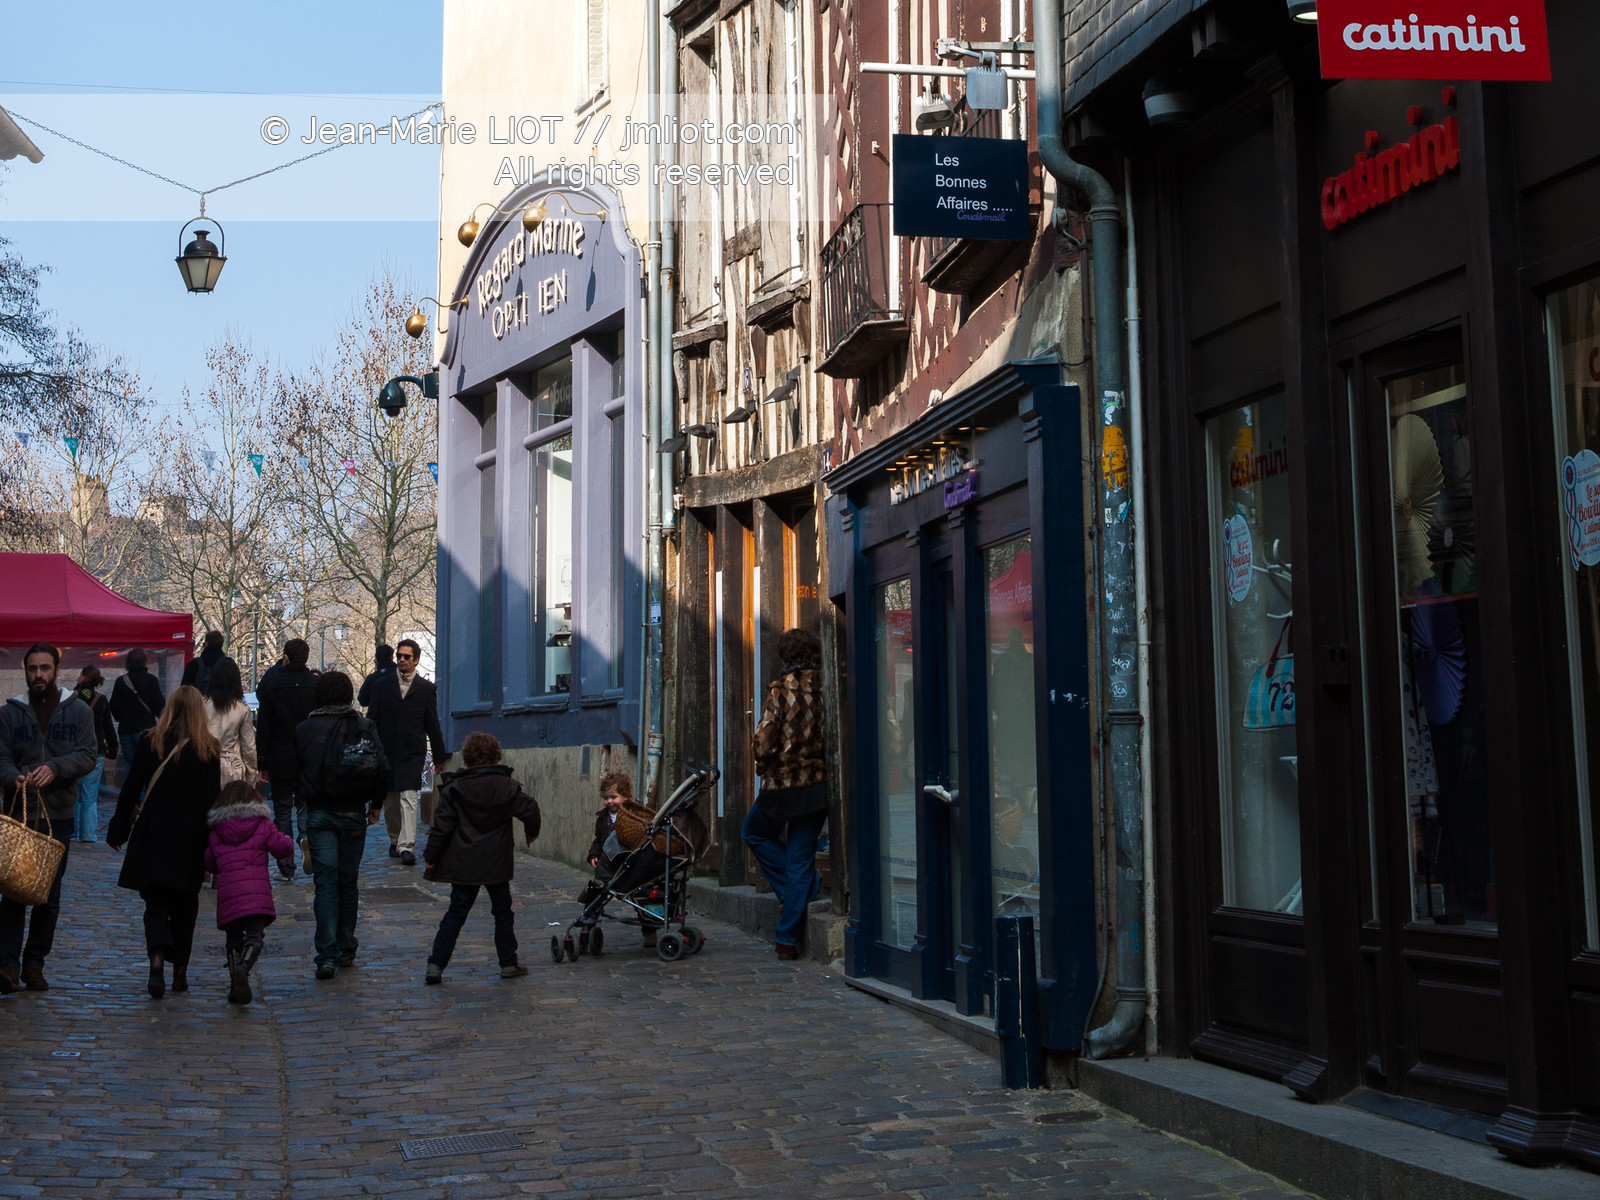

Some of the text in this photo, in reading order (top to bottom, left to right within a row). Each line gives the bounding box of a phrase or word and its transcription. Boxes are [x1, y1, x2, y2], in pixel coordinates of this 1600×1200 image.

[1342, 13, 1526, 53] catimini
[935, 153, 960, 167] Les
[1321, 85, 1460, 231] catimini
[935, 174, 987, 189] Bonnes
[936, 196, 988, 211] Affaires
[477, 205, 585, 316] Regard Marine
[1230, 436, 1289, 489] catimini
